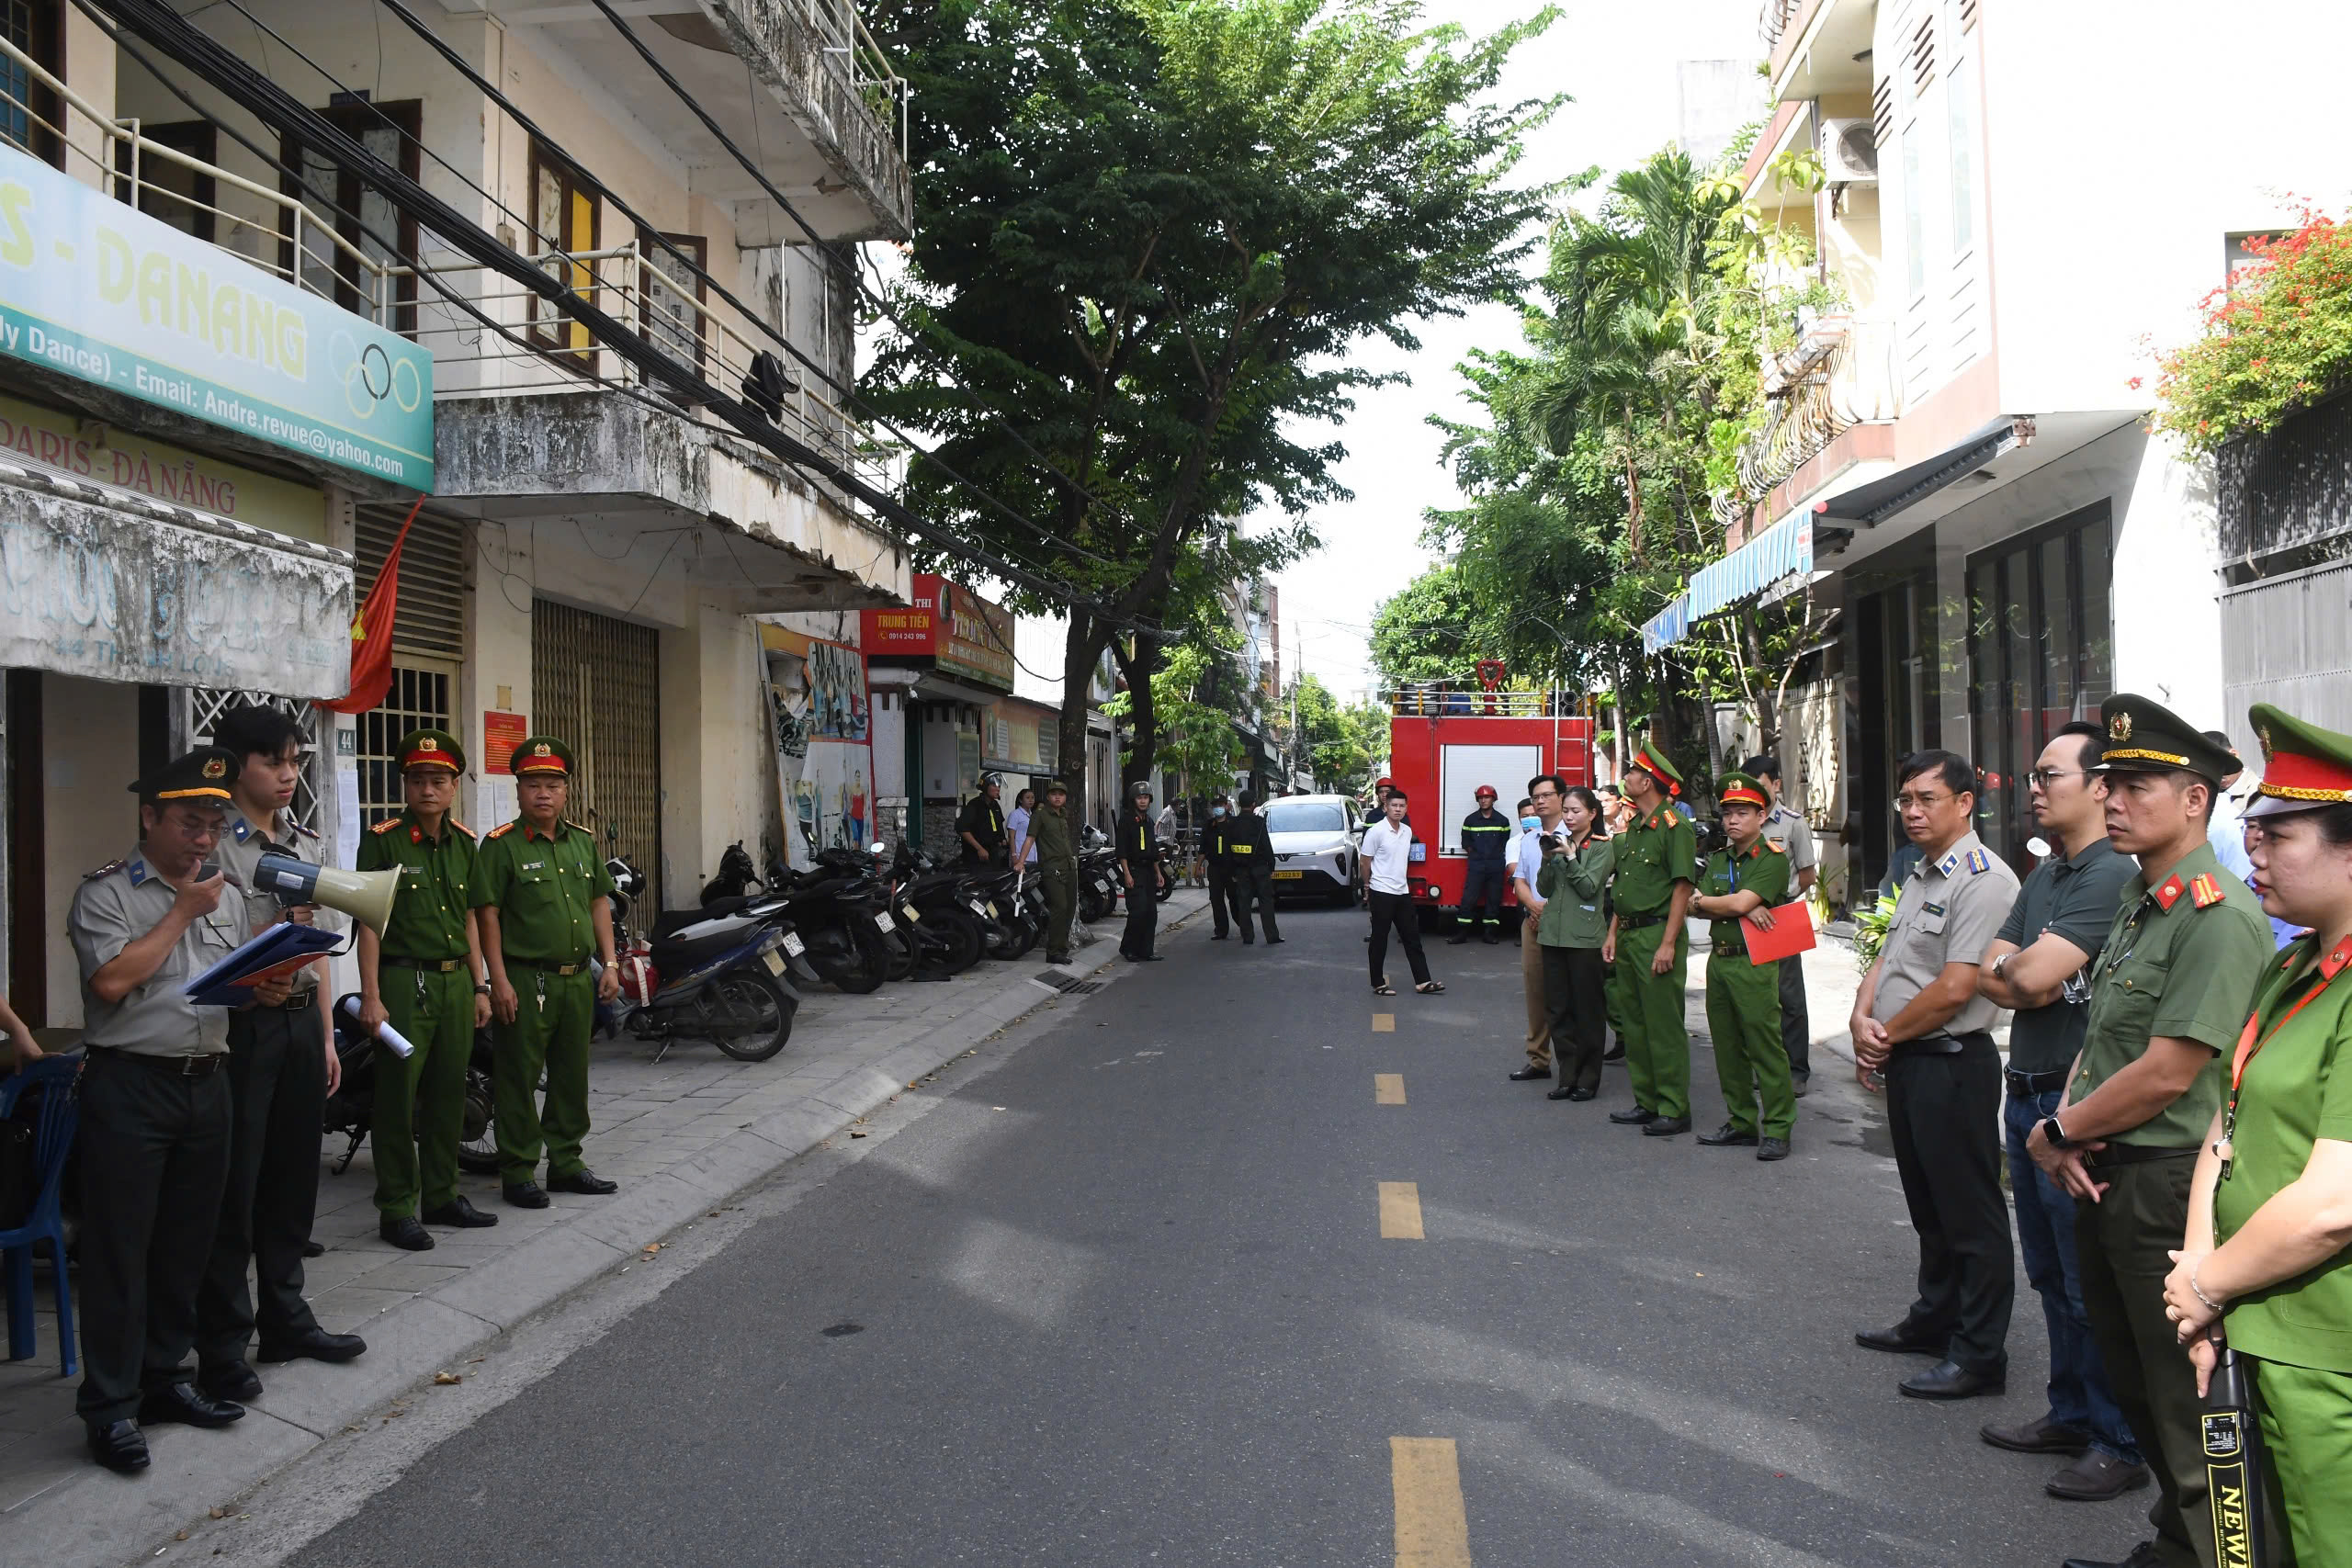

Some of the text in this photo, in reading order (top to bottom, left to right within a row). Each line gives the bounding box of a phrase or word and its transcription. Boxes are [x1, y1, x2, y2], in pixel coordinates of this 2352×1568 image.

[96, 225, 306, 381] DANANG
[28, 326, 110, 382] Dance)
[136, 365, 198, 408] Email:
[204, 389, 403, 478] Andre.revue@yahoo.com
[877, 615, 907, 628] TRUNG
[888, 632, 902, 640] 0914
[341, 731, 352, 749] 44
